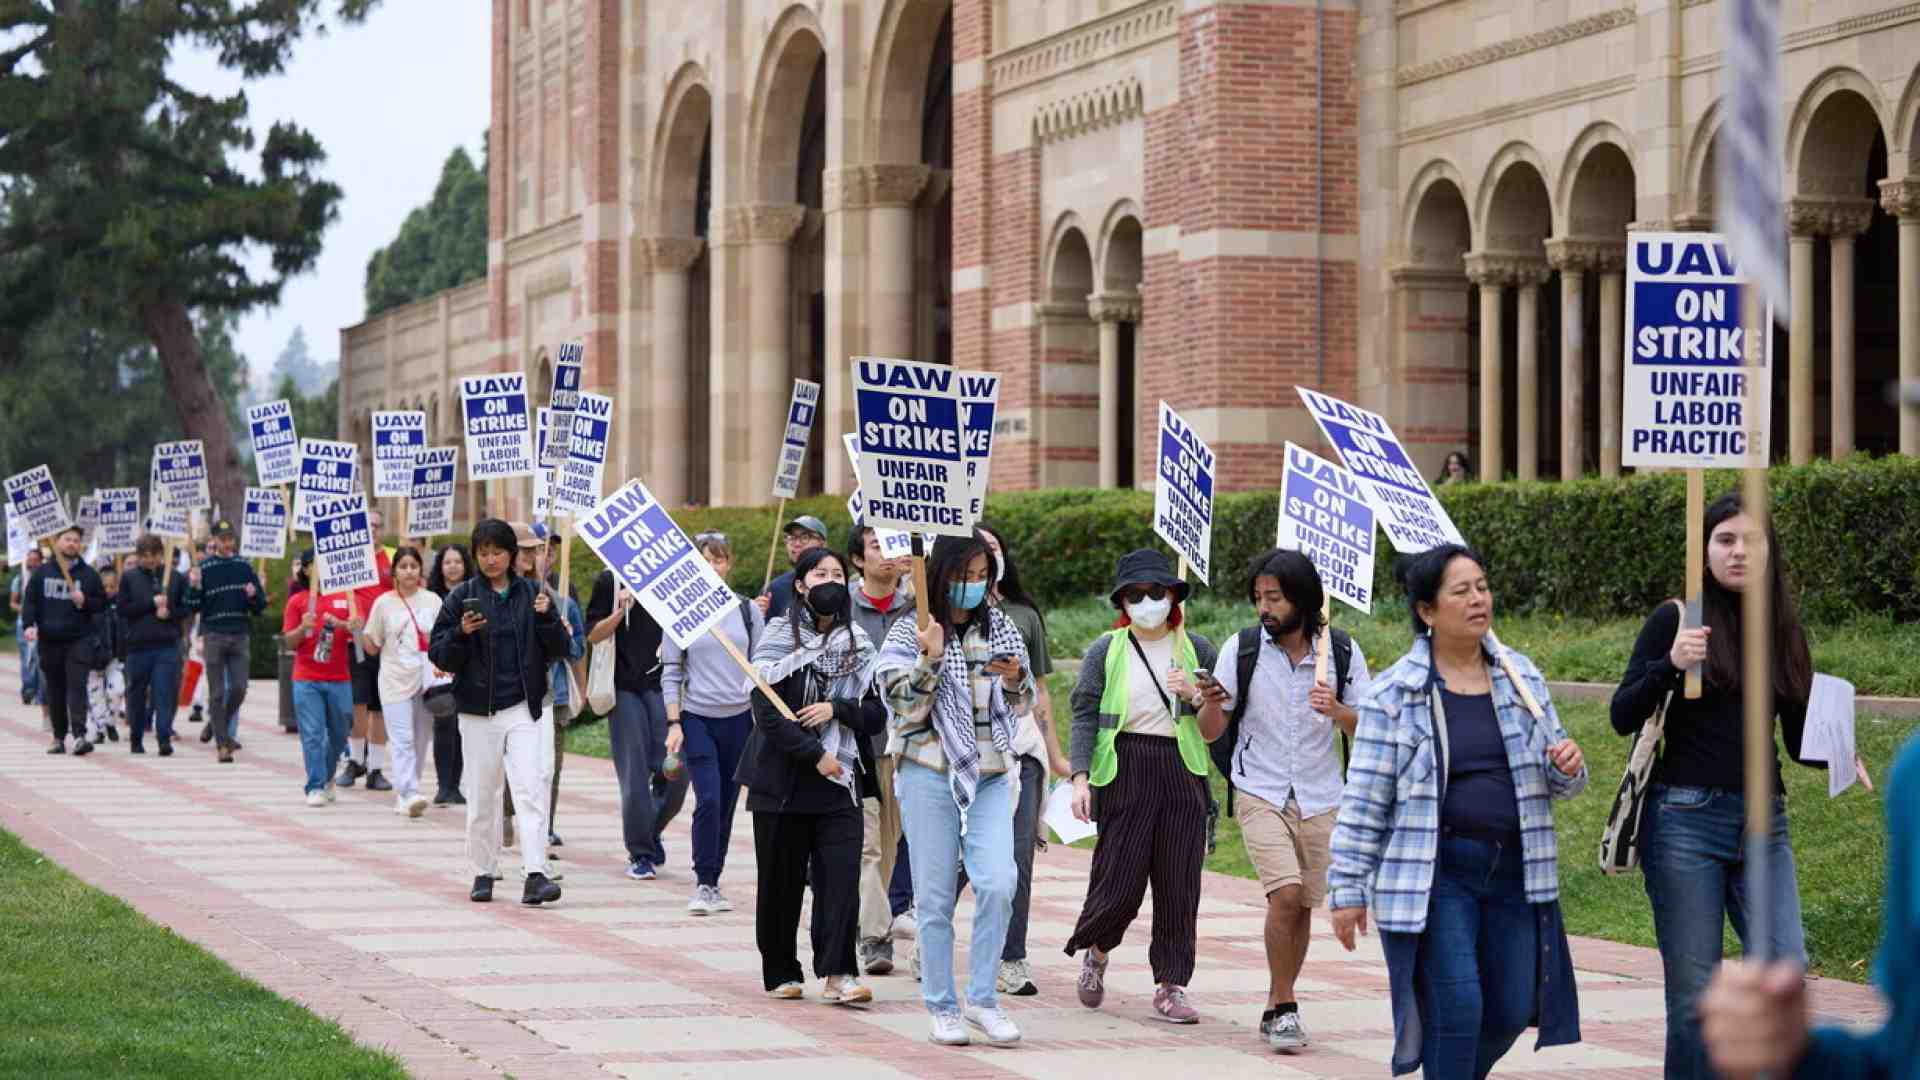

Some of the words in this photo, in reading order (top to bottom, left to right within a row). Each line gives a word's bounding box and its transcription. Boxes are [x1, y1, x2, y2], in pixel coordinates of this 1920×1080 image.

[1675, 288, 1726, 323] ON
[560, 343, 583, 362] UAW
[465, 377, 523, 395] UAW
[859, 361, 952, 392] UAW
[1650, 371, 1748, 397] UNFAIR
[796, 383, 818, 401] UAW
[250, 402, 286, 419] UAW
[484, 398, 508, 415] ON
[888, 396, 928, 423] ON
[1307, 392, 1385, 434] UAW
[1655, 400, 1744, 426] LABOR
[263, 418, 280, 433] ON
[376, 415, 423, 427] UAW
[469, 414, 526, 433] STRIKE
[575, 417, 594, 438] ON
[255, 430, 293, 449] STRIKE
[389, 431, 409, 445] ON
[477, 434, 521, 449] UNFAIR
[864, 421, 958, 454] STRIKE
[1166, 409, 1212, 471] UAW
[1349, 429, 1389, 461] ON
[159, 443, 199, 455] UAW
[307, 444, 352, 458] UAW
[415, 451, 455, 465] UAW
[481, 448, 520, 461] LABOR
[172, 456, 190, 469] ON
[316, 461, 337, 477] ON
[472, 459, 530, 474] PRACTICE
[563, 463, 594, 479] UNFAIR
[877, 459, 948, 483] UNFAIR
[1180, 448, 1200, 490] ON
[1343, 448, 1425, 494] STRIKE
[9, 469, 46, 489] UAW
[160, 467, 202, 482] STRIKE
[302, 474, 351, 492] STRIKE
[425, 468, 441, 482] ON
[563, 475, 592, 492] LABOR
[102, 491, 137, 499] UAW
[412, 480, 453, 497] STRIKE
[882, 479, 946, 504] LABOR
[1163, 454, 1210, 519] STRIKE
[16, 490, 56, 512] STRIKE
[312, 496, 362, 517] UAW
[555, 487, 597, 508] PRACTICE
[1312, 487, 1347, 519] ON
[1373, 485, 1438, 521] UNFAIR
[247, 513, 284, 526] STRIKE
[584, 483, 648, 539] UAW
[869, 499, 964, 526] PRACTICE
[1168, 487, 1202, 537] UNFAIR
[1388, 506, 1446, 537] LABOR
[330, 516, 351, 534] ON
[621, 518, 657, 551] ON
[1169, 505, 1200, 551] LABOR
[1287, 496, 1371, 552] STRIKE
[318, 529, 369, 553] STRIKE
[1160, 513, 1207, 575] PRACTICE
[1295, 523, 1359, 567] UNFAIR
[326, 548, 365, 564] UNFAIR
[621, 527, 688, 584] STRIKE
[330, 560, 365, 577] LABOR
[324, 570, 373, 590] PRACTICE
[651, 560, 701, 601] UNFAIR
[1319, 569, 1368, 605] CTICE
[666, 576, 713, 616] LABOR
[671, 585, 733, 639] PRACTICE
